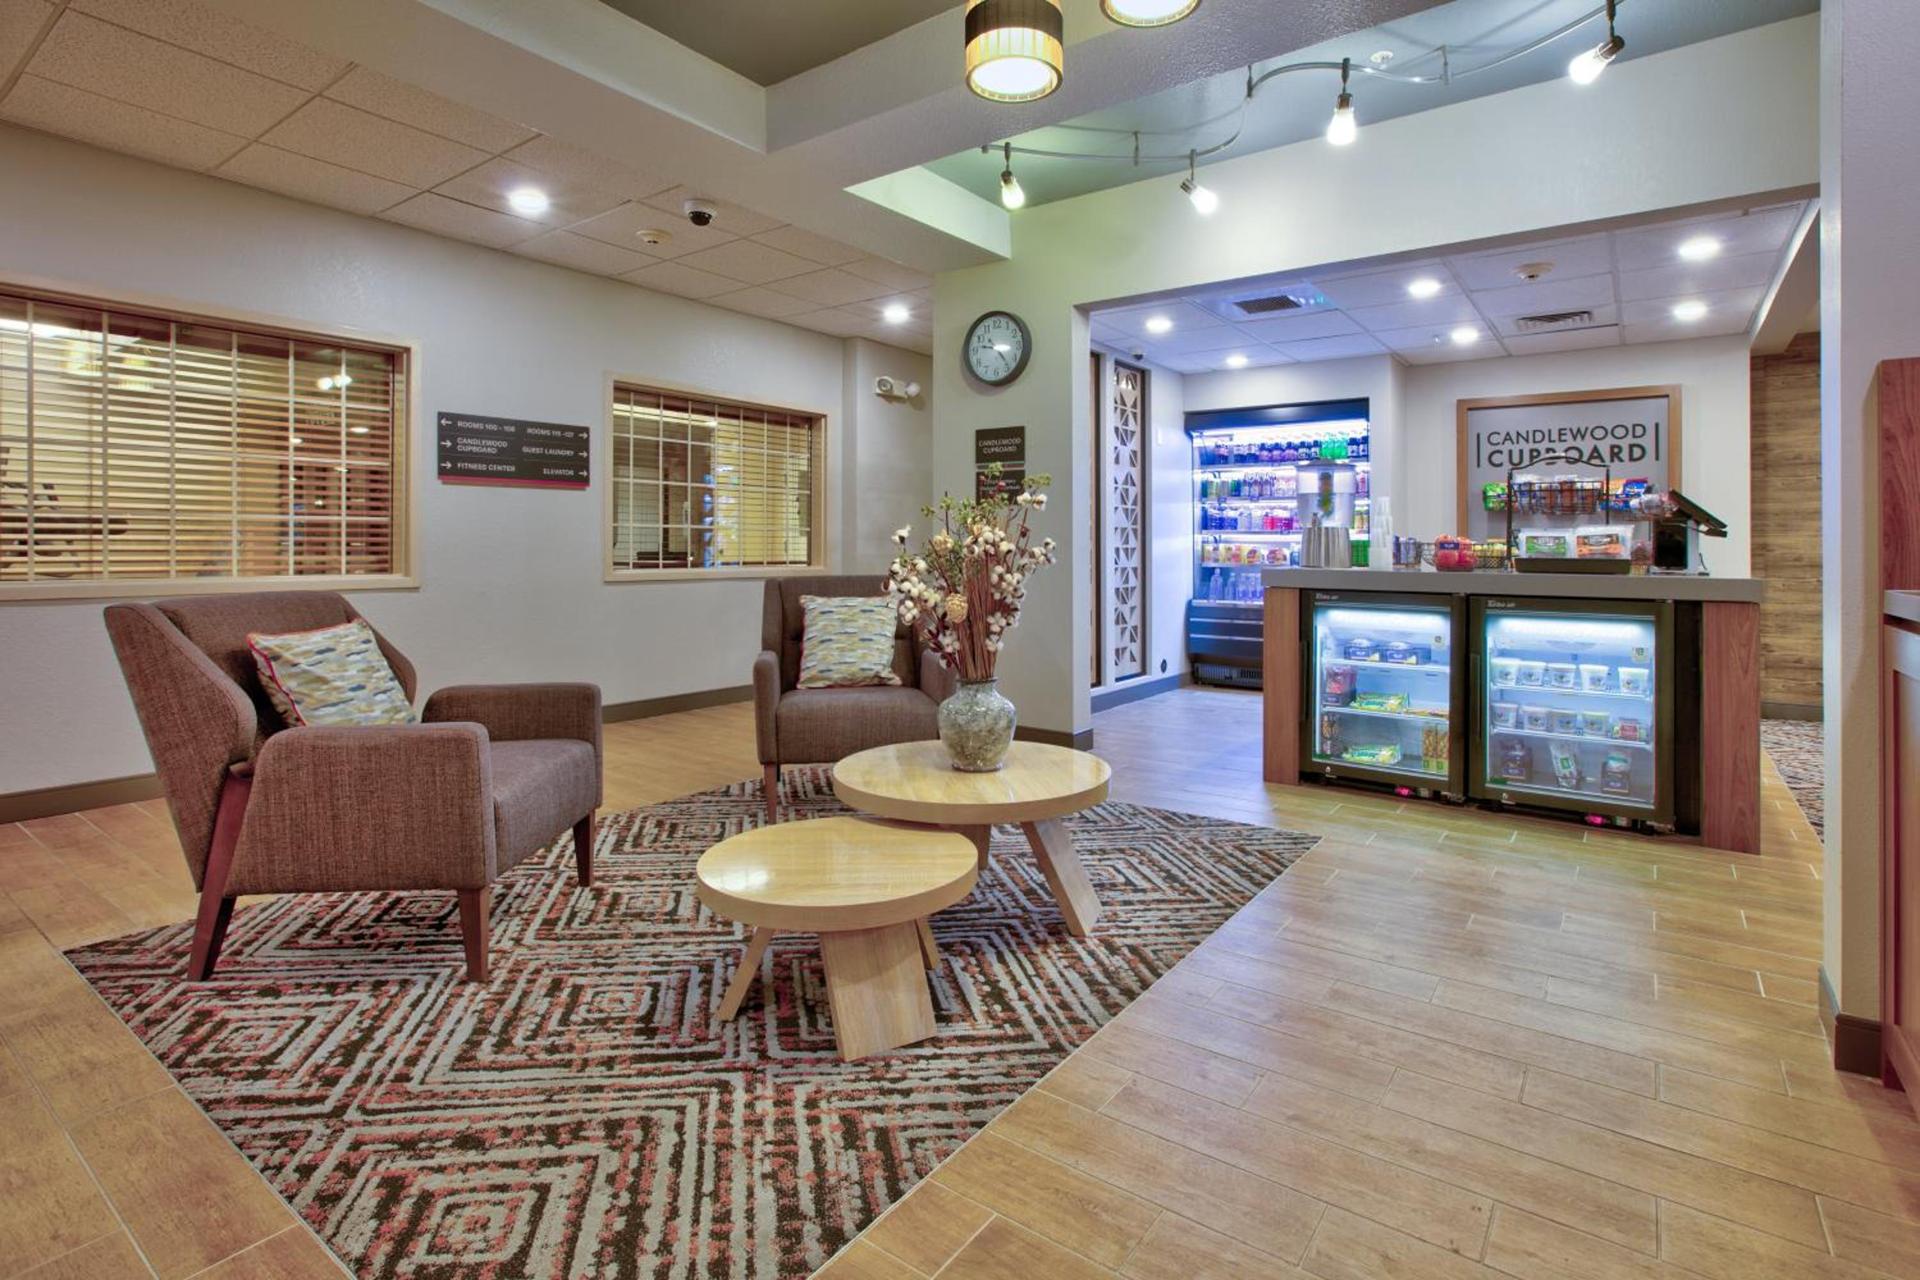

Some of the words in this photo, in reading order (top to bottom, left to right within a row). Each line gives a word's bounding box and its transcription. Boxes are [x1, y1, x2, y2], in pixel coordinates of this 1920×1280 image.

[993, 318, 1002, 329] 12
[1011, 328, 1017, 339] 2
[457, 420, 484, 430] ROOMS
[527, 428, 551, 436] ROOMS
[1487, 423, 1647, 446] CANDLEWOOD
[522, 446, 543, 454] GUEST
[544, 448, 574, 457] LAUNDRY
[457, 462, 487, 471] FITNESS
[488, 464, 516, 472] CENTER
[543, 467, 575, 476] ELEVATOR
